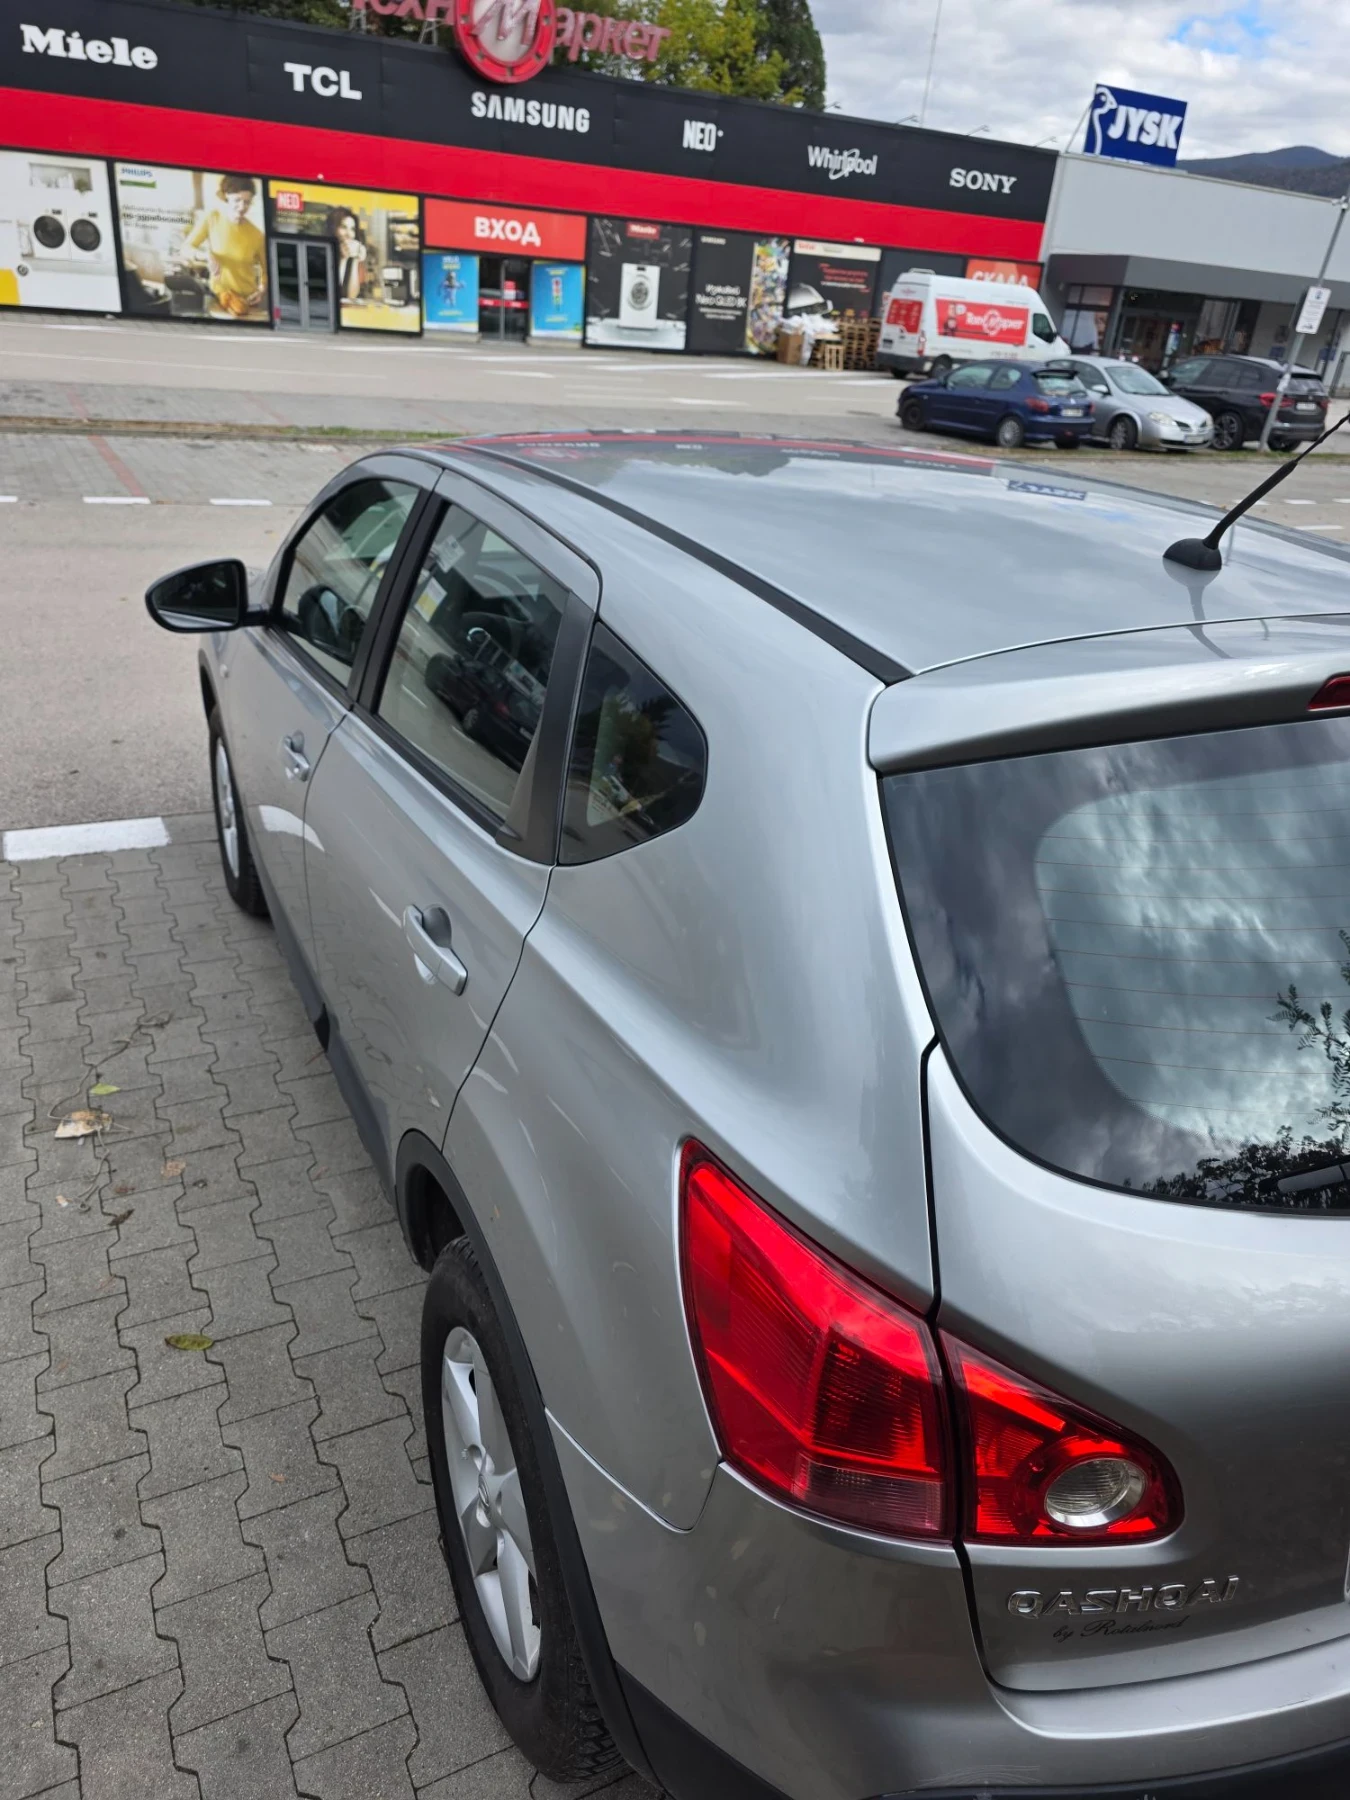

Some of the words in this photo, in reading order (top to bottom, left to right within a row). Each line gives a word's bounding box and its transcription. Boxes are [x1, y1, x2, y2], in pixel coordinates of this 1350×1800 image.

[20, 24, 158, 70] Miele
[283, 62, 363, 100] TCL
[471, 91, 590, 134] SAMSUNG
[1107, 104, 1182, 150] JYSK
[806, 145, 878, 181] Whirlpool
[949, 167, 1018, 194] SONY
[473, 215, 542, 248] ВХОД
[1006, 1574, 1240, 1619] QASHQAI
[1053, 1625, 1074, 1644] by
